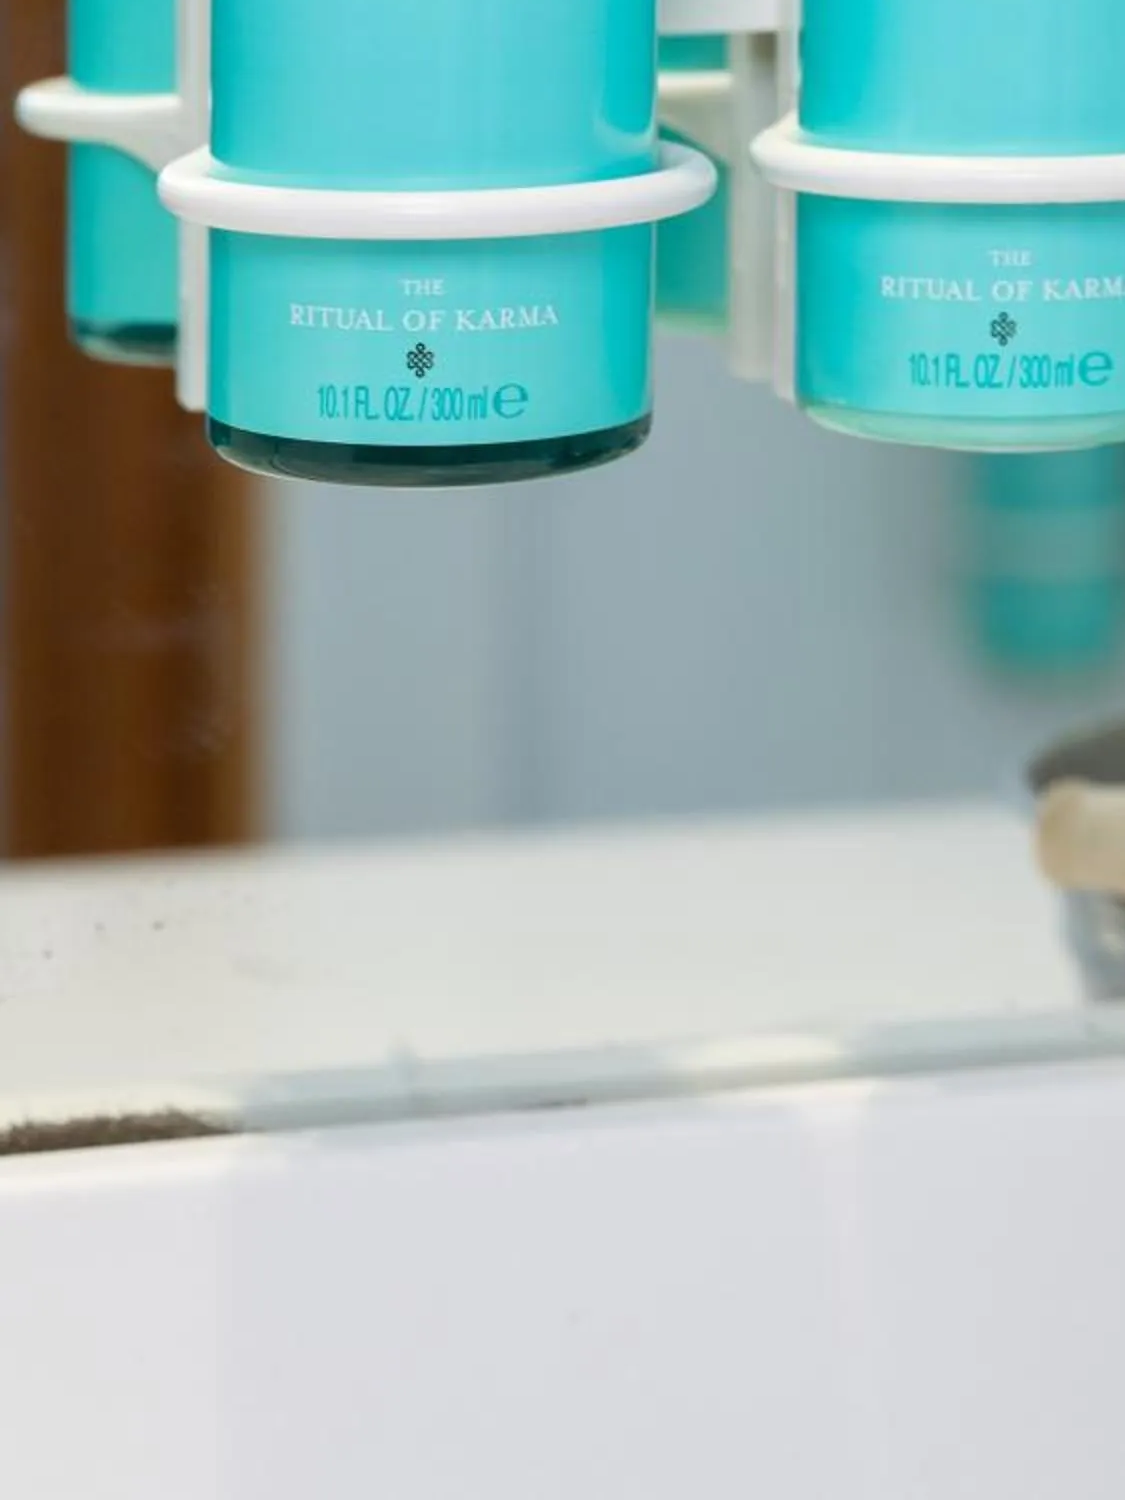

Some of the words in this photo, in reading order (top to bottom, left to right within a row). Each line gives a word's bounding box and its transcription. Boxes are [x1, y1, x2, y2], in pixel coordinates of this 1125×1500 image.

[989, 250, 1032, 267] THE
[401, 279, 445, 296] THE
[880, 276, 982, 301] RITUAL
[991, 281, 1034, 302] OF
[290, 304, 393, 332] RITUAL
[403, 309, 446, 332] OF
[457, 305, 560, 332] KARMA
[317, 385, 349, 419] 10.1
